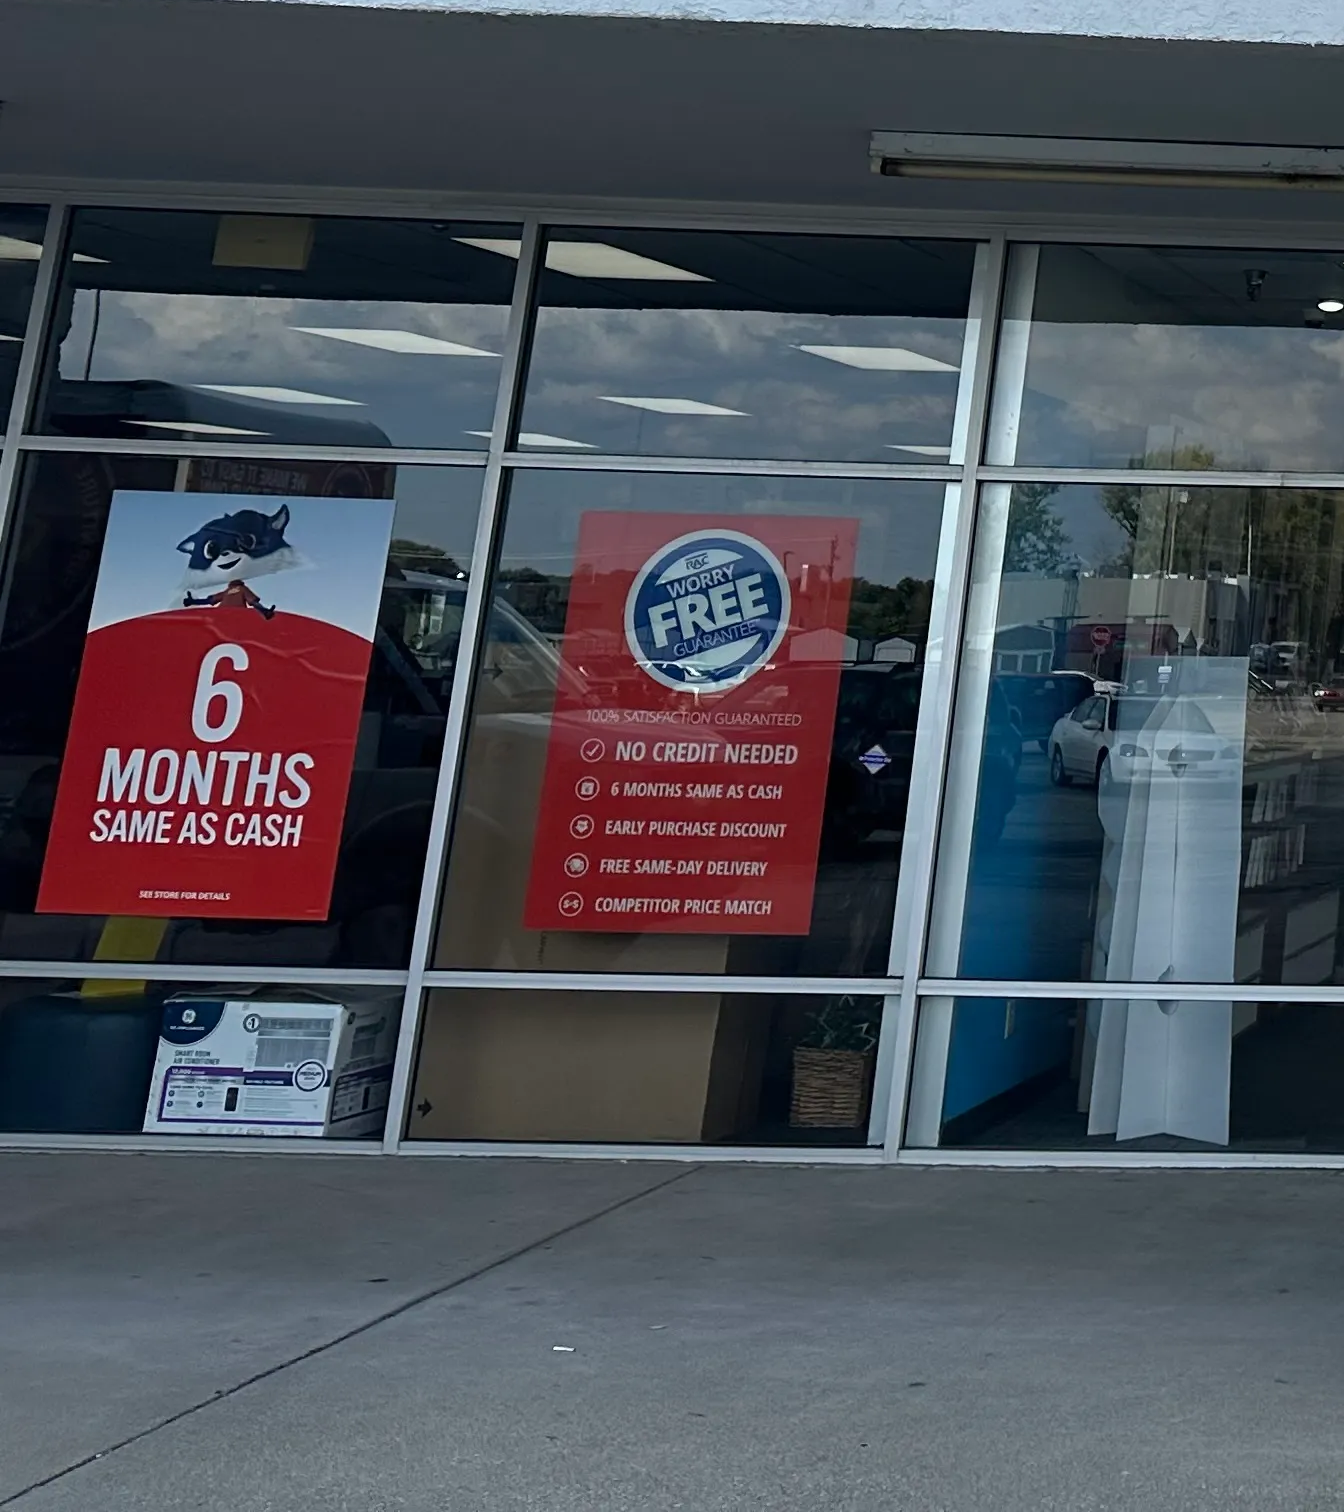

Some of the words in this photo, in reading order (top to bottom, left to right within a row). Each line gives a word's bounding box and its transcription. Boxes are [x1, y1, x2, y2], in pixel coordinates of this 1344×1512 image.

[666, 564, 735, 598] WORRY
[648, 573, 769, 648] FREE
[674, 622, 757, 657] GUARANTEE
[192, 643, 249, 743] 6
[586, 709, 619, 724] 100%
[623, 710, 711, 725] SATISFACTION
[715, 711, 802, 727] GUARANTEED
[615, 741, 646, 762] NO
[652, 742, 720, 763] CREDIT
[724, 743, 799, 765] NEEDED
[97, 748, 315, 809] MONTHS
[611, 782, 619, 796] 6
[623, 782, 682, 798] MONTHS
[685, 783, 723, 798] SAME
[726, 784, 744, 799] AS
[748, 785, 783, 800] CASH
[89, 809, 175, 844] SAME
[177, 812, 219, 845] AS
[225, 813, 304, 847] CASH
[605, 820, 646, 835] EARLY
[648, 821, 716, 837] PURCHASE
[720, 822, 787, 838] DISCOUNT
[599, 858, 631, 873] FREE
[633, 859, 703, 875] SAME-DAY
[707, 860, 768, 876] DELIVERY
[154, 891, 179, 900] STORE
[181, 891, 197, 900] FOR
[198, 891, 231, 901] DETAILS
[595, 897, 680, 913] COMPETITOR
[684, 899, 720, 914] PRICE
[724, 900, 772, 915] MATCH
